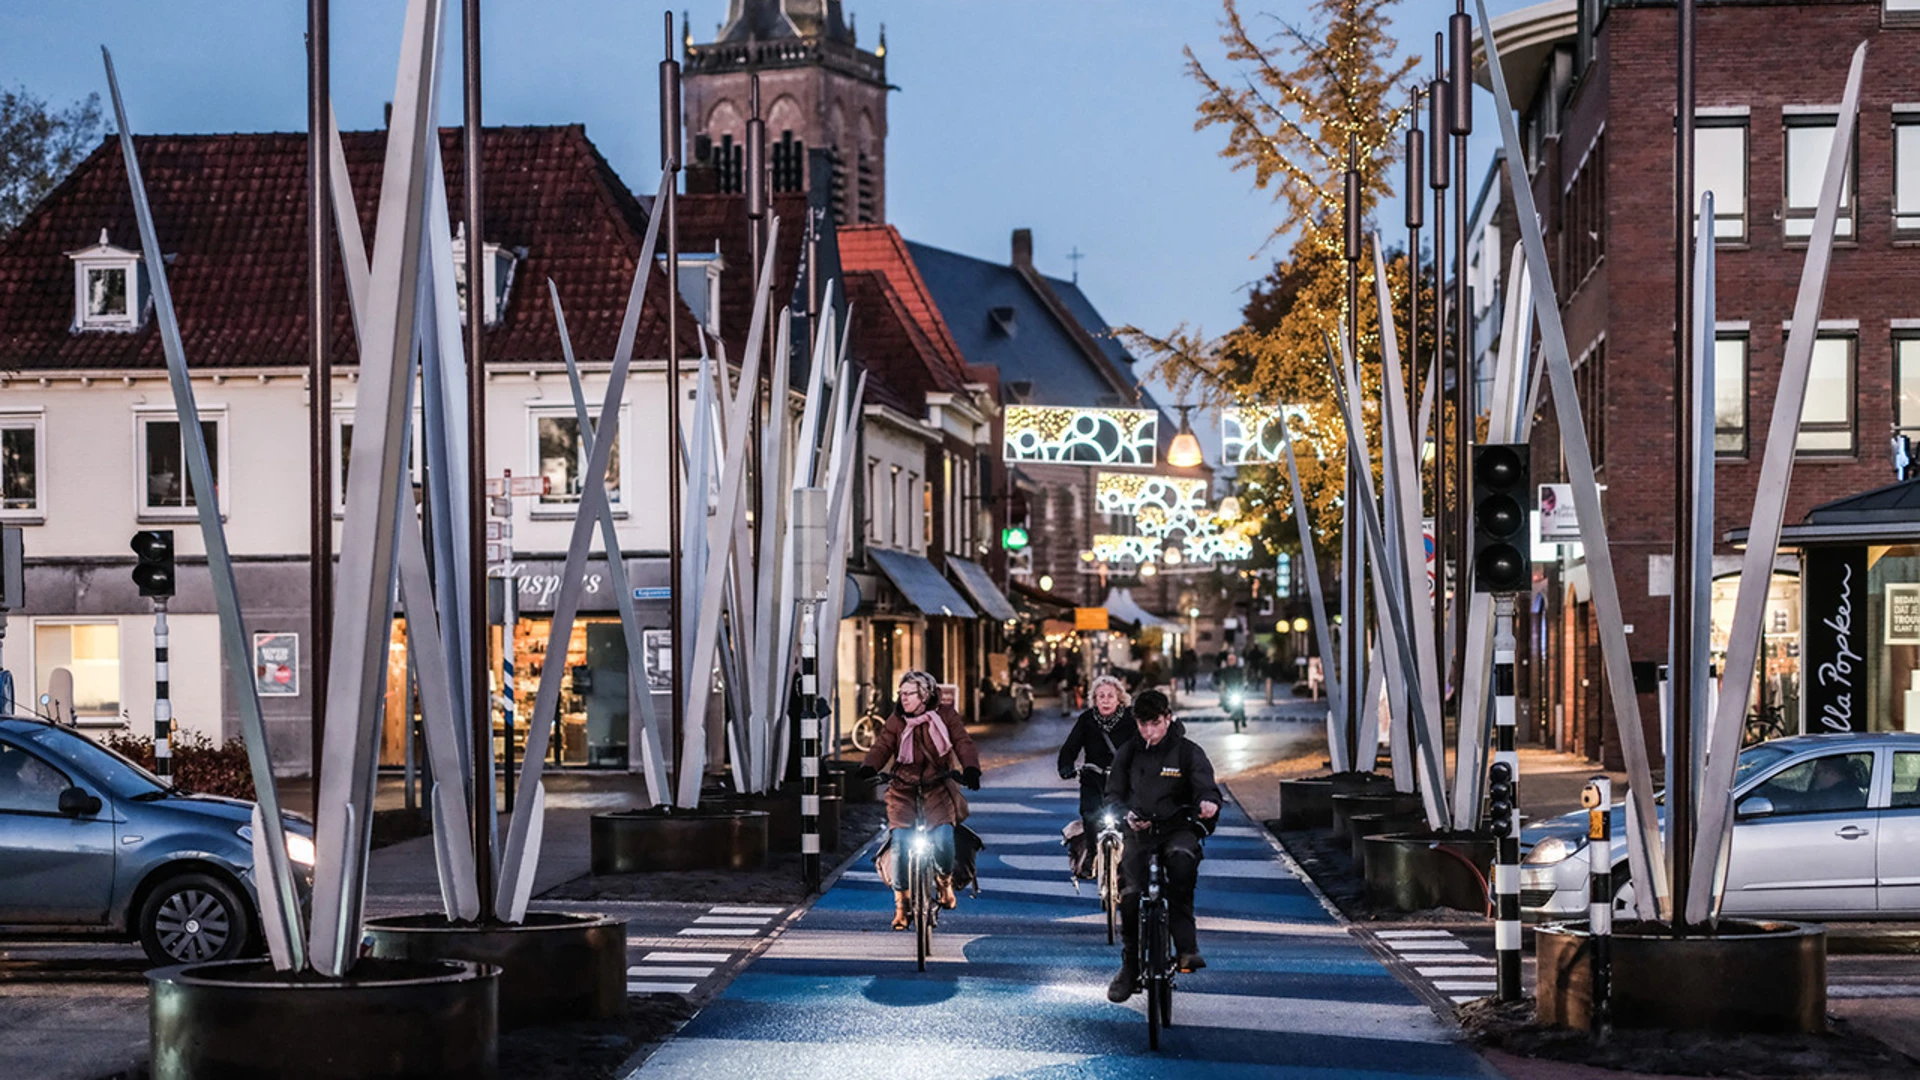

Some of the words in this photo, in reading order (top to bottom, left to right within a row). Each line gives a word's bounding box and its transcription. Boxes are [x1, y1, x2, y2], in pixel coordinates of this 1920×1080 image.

[1817, 563, 1863, 687] Popken
[1894, 605, 1909, 614] DAT
[1821, 692, 1852, 733] lla
